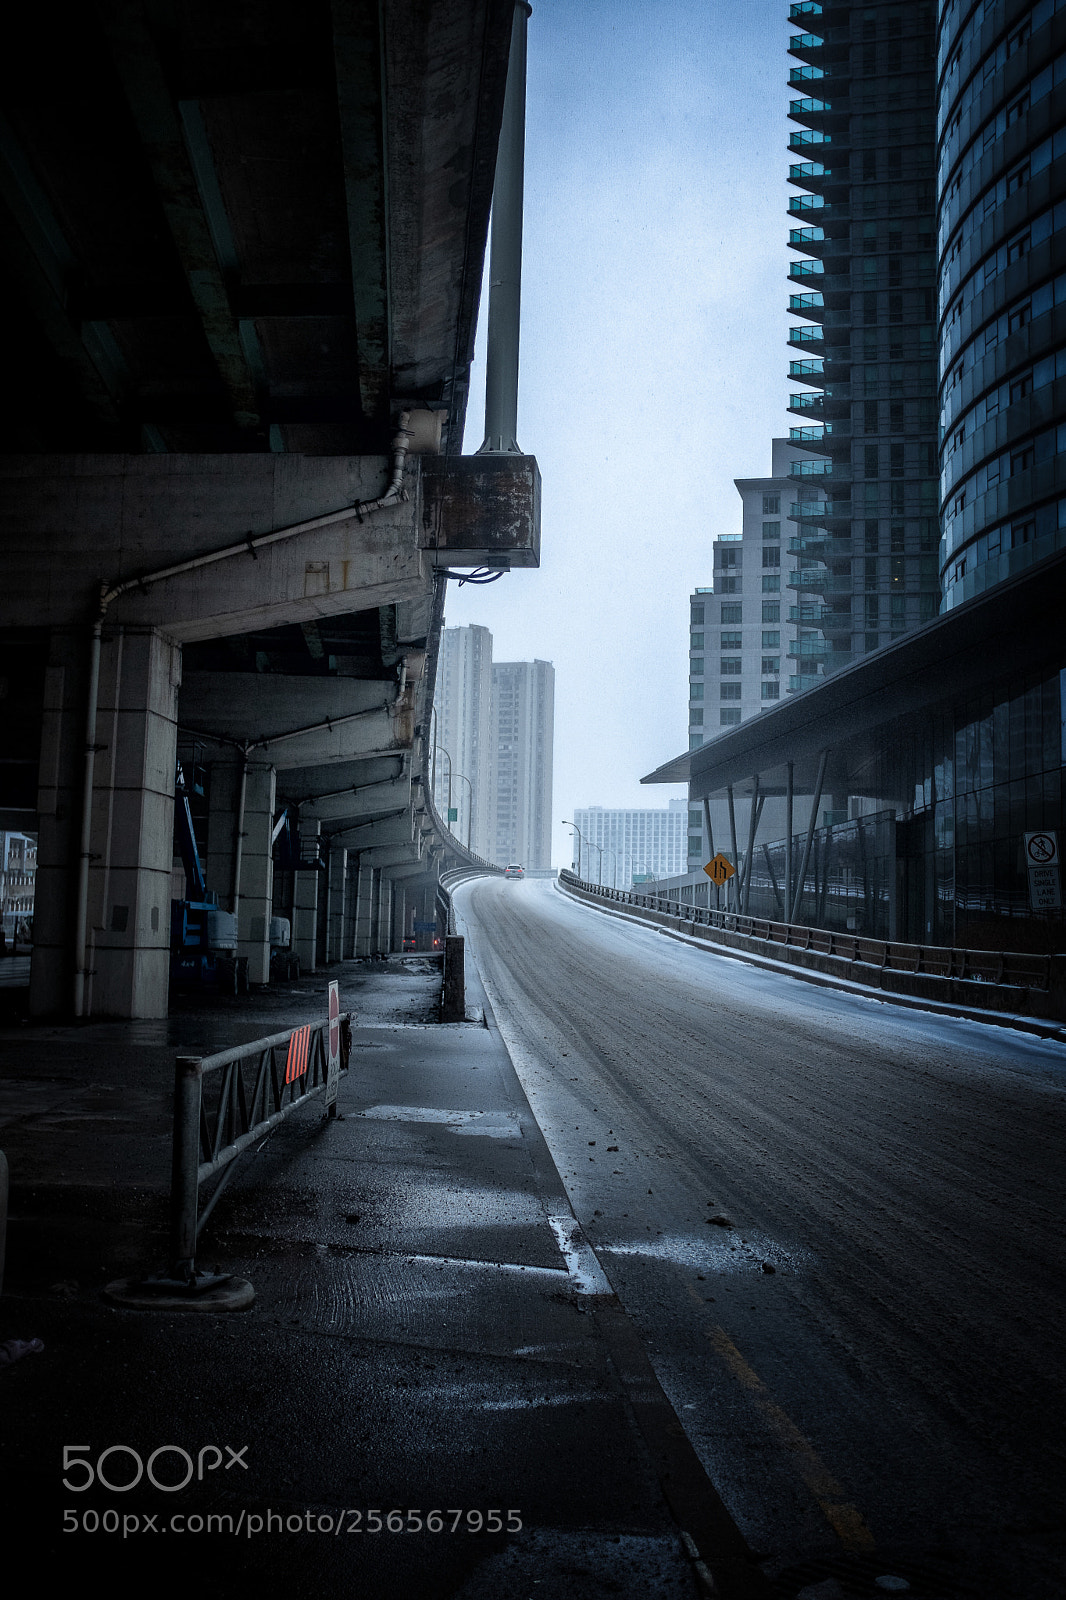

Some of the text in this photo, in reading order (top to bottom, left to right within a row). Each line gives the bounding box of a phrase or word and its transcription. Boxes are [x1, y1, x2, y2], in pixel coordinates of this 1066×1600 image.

[1034, 870, 1054, 878] DRIVE
[1033, 879, 1056, 887] SINGLE
[1037, 888, 1056, 896] LANE
